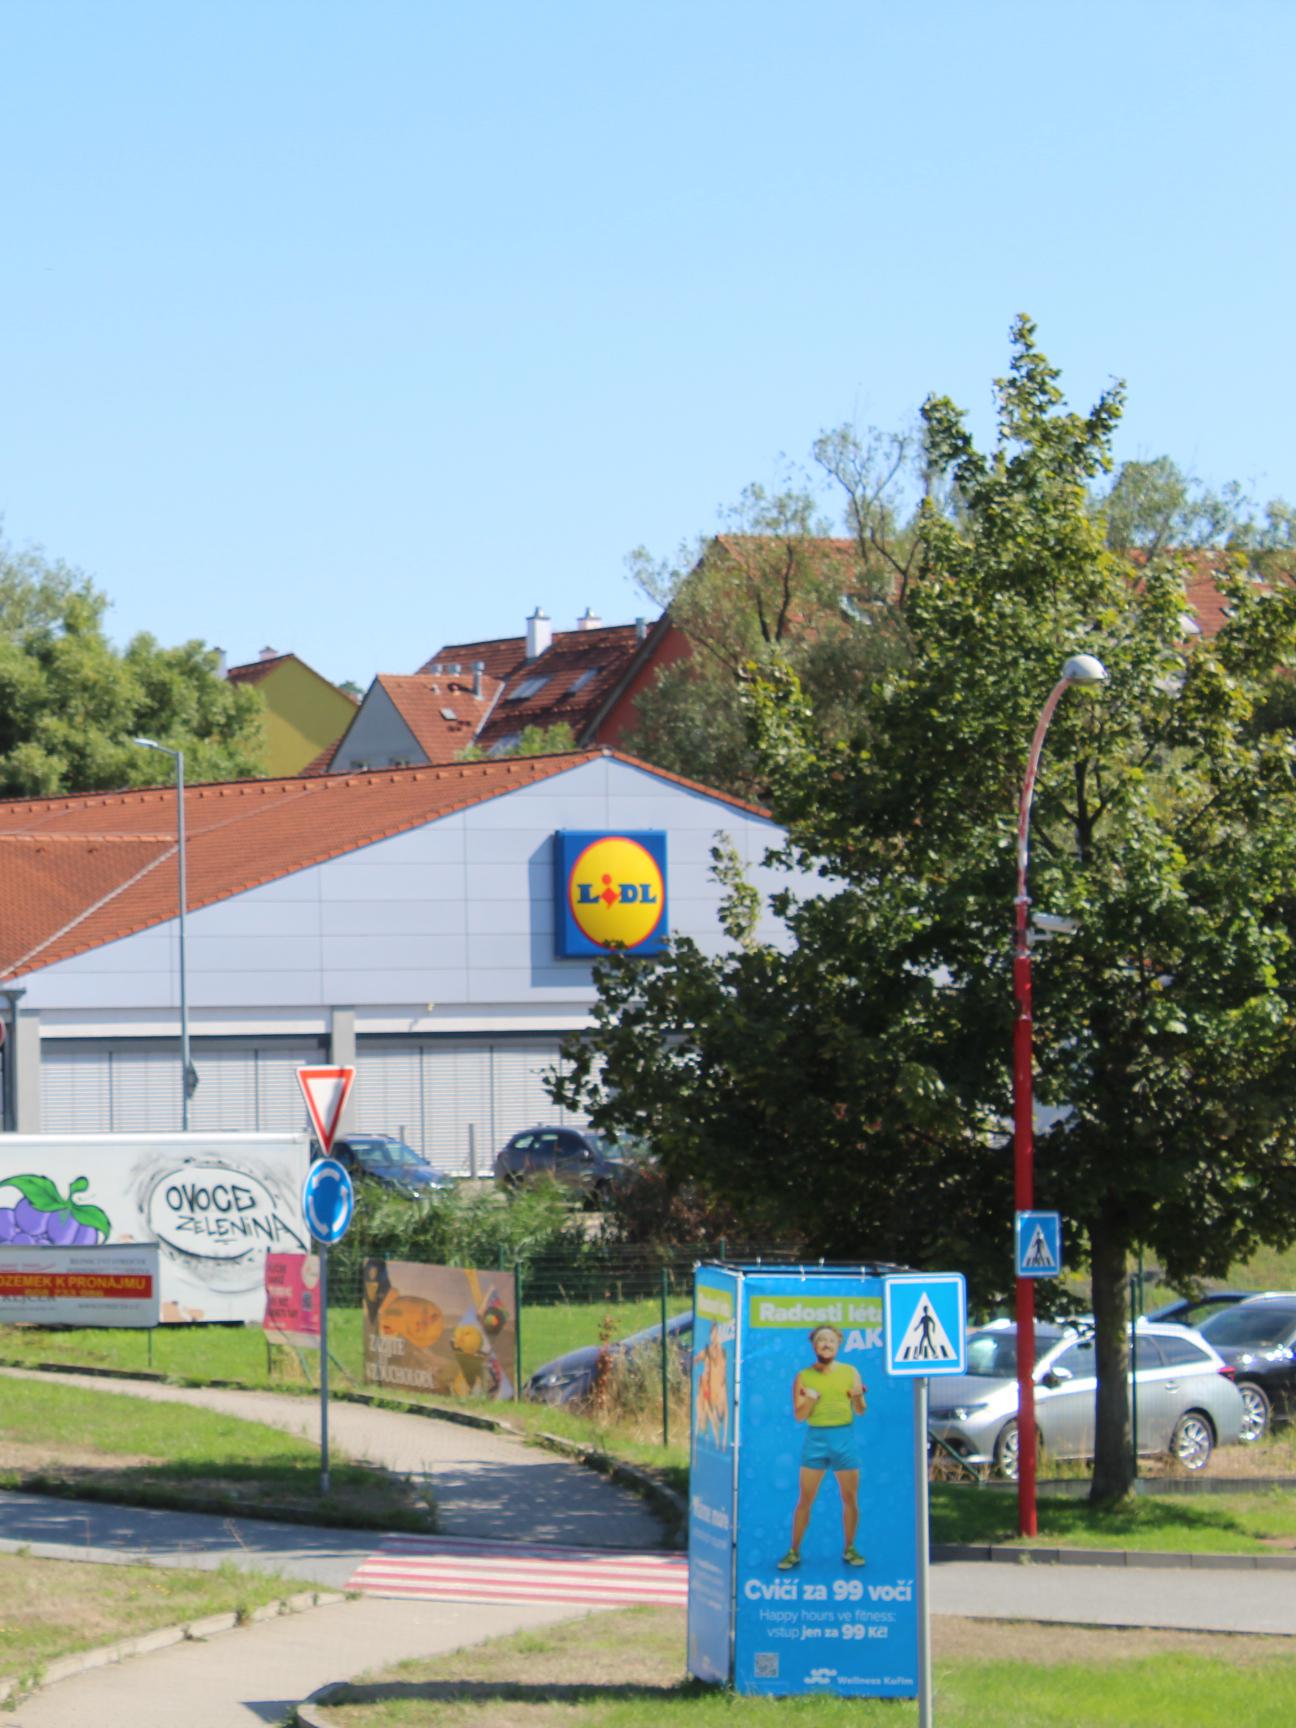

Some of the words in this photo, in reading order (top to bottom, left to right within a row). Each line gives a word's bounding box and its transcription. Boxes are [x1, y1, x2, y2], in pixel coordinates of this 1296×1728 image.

[166, 1184, 256, 1213] OVOCE
[56, 1276, 67, 1287] K
[759, 1302, 843, 1322] Radosti
[744, 1578, 799, 1600] Cvičí
[803, 1584, 828, 1600] za
[832, 1579, 863, 1601] 99
[867, 1579, 914, 1602] vočí
[759, 1608, 799, 1624] Happy
[801, 1608, 835, 1622] hours
[838, 1611, 853, 1622] ve
[766, 1627, 800, 1640] vstup
[800, 1625, 822, 1641] jen
[824, 1628, 839, 1638] za
[842, 1624, 865, 1640] 99
